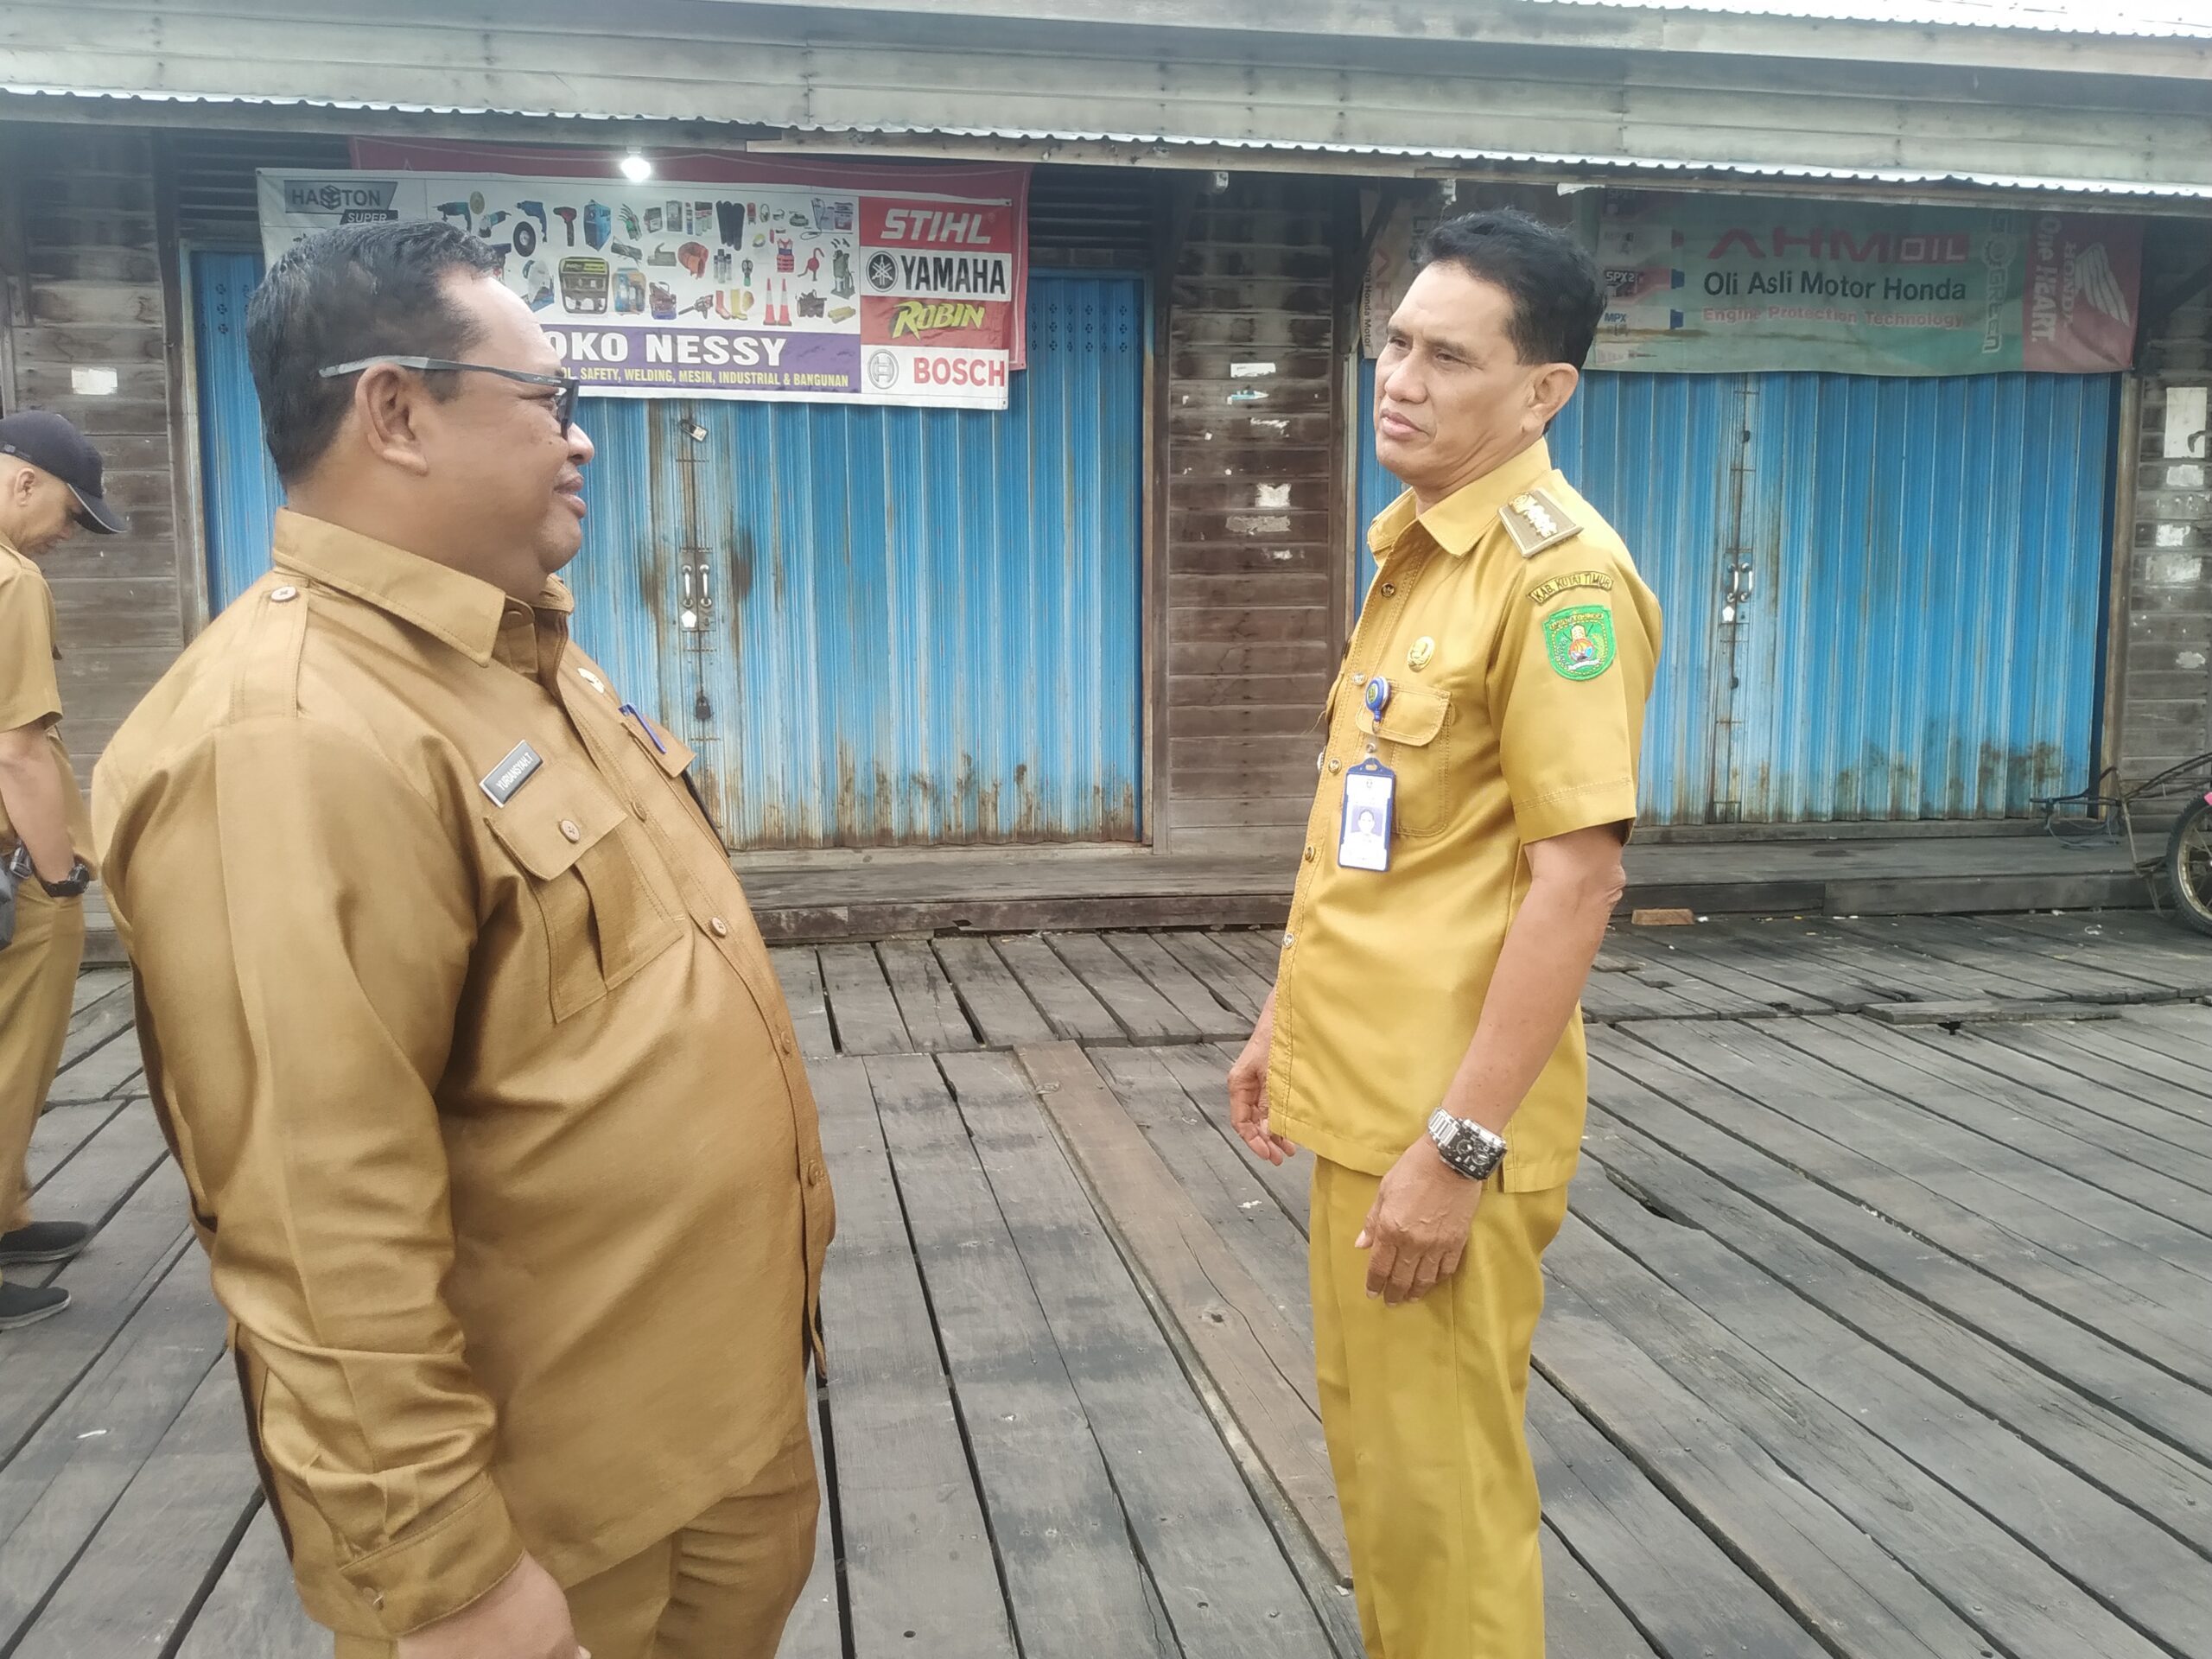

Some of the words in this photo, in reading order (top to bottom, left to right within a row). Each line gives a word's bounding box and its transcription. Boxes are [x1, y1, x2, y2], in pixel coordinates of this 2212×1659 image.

[880, 208, 992, 245] STIHL
[900, 255, 1006, 295] YAMAHA
[1704, 271, 1738, 296] Oli
[1747, 270, 1792, 295] Asli
[1801, 270, 1876, 299] Motor
[1883, 277, 1966, 301] Honda
[1363, 285, 1372, 317] Honda
[1604, 312, 1627, 323] MPX
[1702, 307, 1761, 324] Engine
[1769, 306, 1857, 324] Protection
[1865, 310, 1964, 330] Technology
[549, 331, 629, 363] OKO
[645, 334, 788, 366] NESSY
[1363, 319, 1372, 348] Motor
[580, 367, 622, 382] SAFETY,
[624, 369, 676, 384] WELDING,
[678, 371, 716, 385] MESIN,
[719, 372, 781, 386] INDUSTRIAL
[784, 373, 791, 385] &
[793, 374, 849, 388] BANGUNAN
[913, 357, 1005, 387] BOSCH
